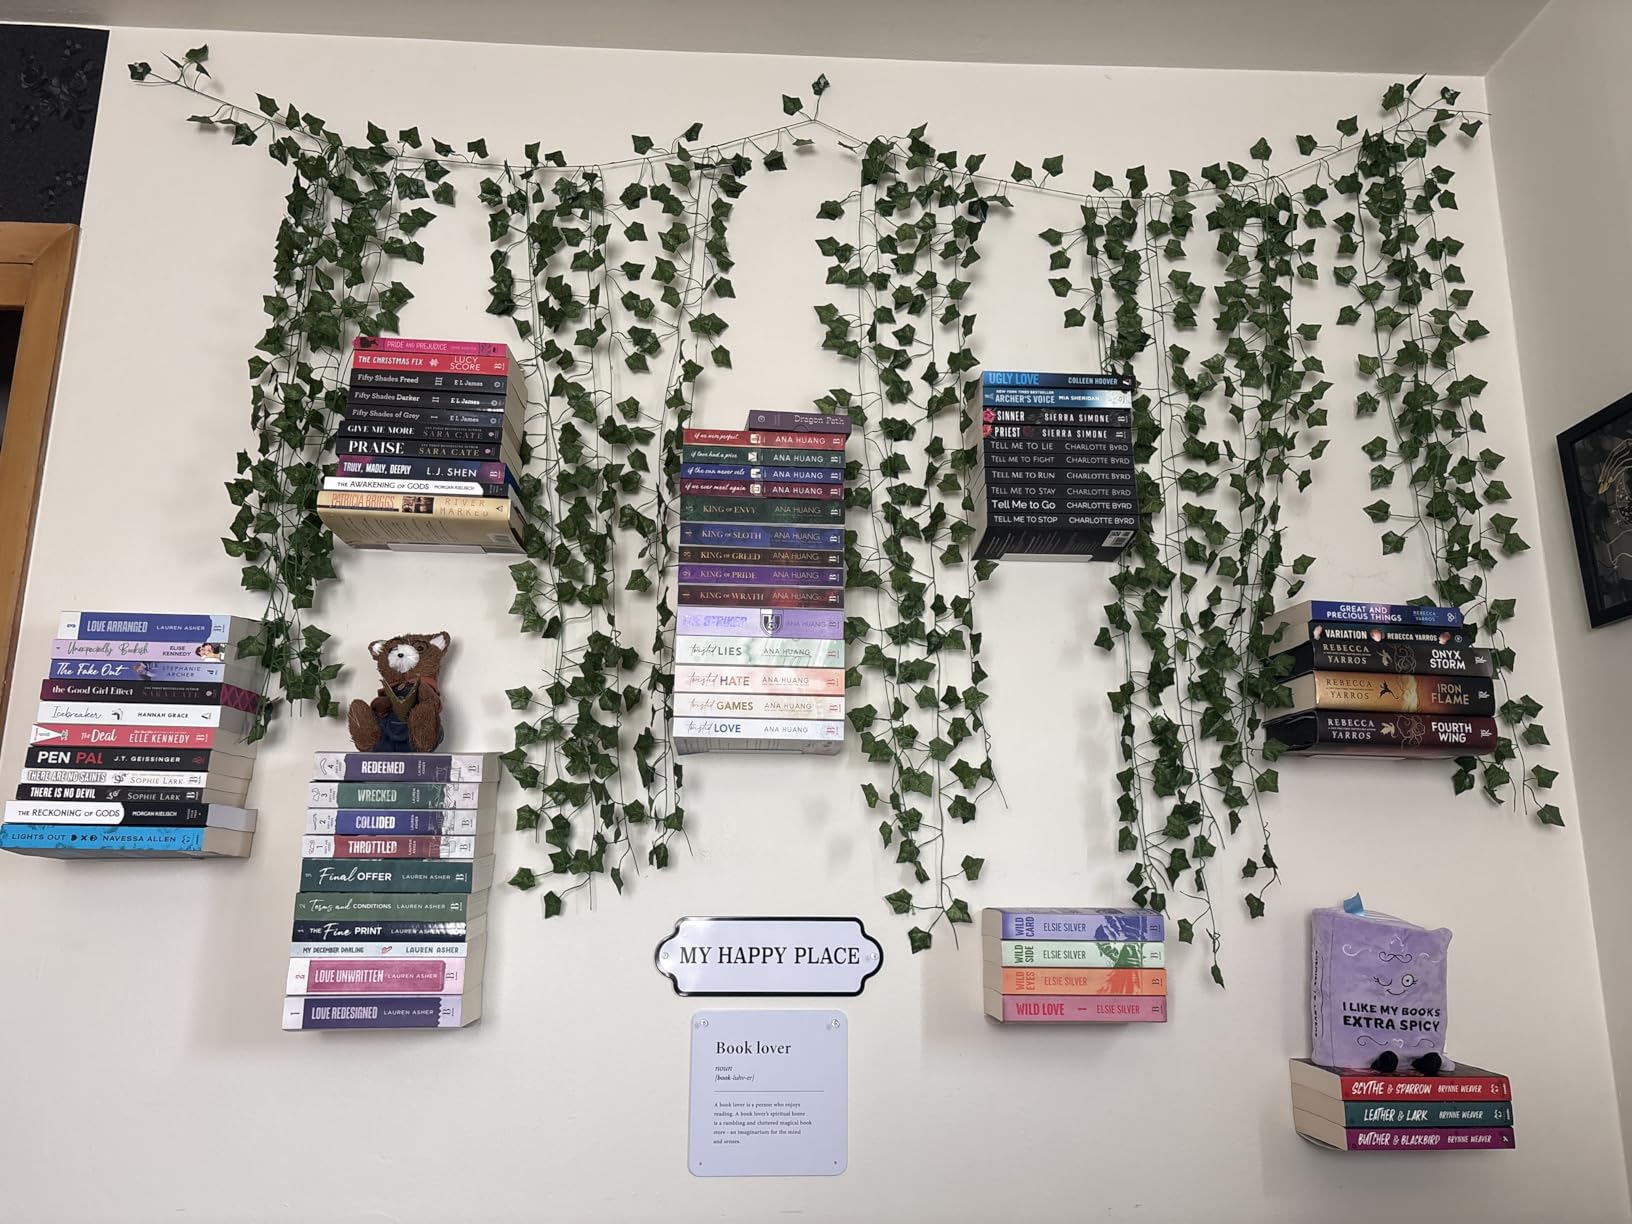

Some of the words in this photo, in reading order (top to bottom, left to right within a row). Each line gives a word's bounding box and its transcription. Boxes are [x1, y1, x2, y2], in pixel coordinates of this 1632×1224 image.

[358, 356, 370, 364] THE
[373, 356, 409, 365] CHRISTMAS
[412, 358, 423, 366] FIX
[454, 356, 477, 364] LUCY
[450, 363, 480, 371] SCORE
[358, 374, 373, 382] Fifty
[400, 376, 418, 384] Freed
[989, 373, 1013, 385] UGLY
[1016, 373, 1039, 385] LOVE
[354, 392, 370, 400] Fifty
[396, 394, 420, 402] Darker
[995, 394, 1032, 404] ARCHER'S
[1033, 395, 1055, 404] VOICE
[997, 411, 1024, 421] SINNER
[1045, 413, 1074, 422] SIERRA
[1079, 415, 1109, 423] SIMONE
[348, 425, 368, 433] GIVE
[388, 427, 415, 435] MORE
[995, 427, 1020, 438] PRIEST
[1042, 429, 1072, 438] SIERRA
[1077, 430, 1107, 438] SIMONE
[349, 441, 404, 454] PRAISE
[991, 441, 1008, 450] TELL
[1012, 442, 1023, 450] ME
[1026, 442, 1038, 450] TO
[1042, 442, 1053, 450] LIE
[343, 462, 364, 473] TRULY,
[366, 463, 387, 474] MADLY,
[390, 464, 411, 475] DEEPLY
[427, 468, 444, 476] L.J.
[447, 468, 477, 478] SHEN
[992, 500, 1010, 510] Tell
[1012, 500, 1028, 510] Me
[1030, 500, 1039, 510] to
[1041, 501, 1056, 510] Go
[1038, 516, 1058, 524] STOP
[701, 551, 722, 559] KING
[732, 552, 760, 560] GREED
[732, 592, 764, 601] WRATH
[1340, 604, 1366, 614] GREAT
[1327, 611, 1368, 621] PRECIOUS
[1371, 613, 1402, 622] THINGS
[87, 620, 105, 632] LOVE
[107, 621, 148, 633] ARRANGED
[1325, 629, 1367, 640] VARIATION
[718, 647, 742, 656] LIES
[1432, 650, 1462, 661] ONYX
[57, 663, 74, 676] The
[76, 664, 99, 676] Fake
[102, 664, 130, 676] Out
[1430, 659, 1465, 670] STORM
[720, 676, 750, 686] HATE
[1437, 683, 1462, 694] IRON
[1432, 693, 1469, 705] FLAME
[51, 706, 102, 720] Icebreaker
[714, 724, 741, 733] LOVE
[1432, 721, 1472, 733] FOURTH
[129, 733, 149, 743] ELLE
[151, 733, 190, 744] KENNEDY
[1439, 732, 1466, 743] WING
[37, 752, 70, 763] PEN
[76, 754, 103, 764] PAL
[361, 760, 404, 774] REDEEMED
[30, 787, 53, 797] THERE
[55, 788, 62, 797] IS
[64, 788, 75, 798] NO
[76, 788, 96, 799] DEVIL
[358, 789, 397, 802] WRECKED
[356, 816, 395, 829] COLLIDED
[319, 867, 357, 885] Final
[357, 873, 392, 881] OFFER
[1015, 917, 1024, 936] WILD
[1026, 917, 1034, 936] CARD
[1044, 923, 1061, 932] ELSIE
[1064, 923, 1086, 932] SILVER
[680, 946, 712, 964] MY
[718, 946, 787, 964] HAPPY
[794, 947, 860, 965] PLACE
[1015, 944, 1023, 963] WILD
[1025, 945, 1034, 962] SIDE
[1043, 950, 1061, 959] ELSIE
[1064, 951, 1086, 959] SILVER
[315, 970, 334, 983] LOVE
[337, 970, 384, 983] UNWRITTEN
[1016, 972, 1024, 990] WILD
[1045, 977, 1062, 985] ELSIE
[1065, 977, 1087, 986] SILVER
[312, 1007, 330, 1020] LOVE
[332, 1007, 378, 1019] REDESIGNED
[1016, 1003, 1039, 1016] WILD
[1042, 1003, 1065, 1016] LOVE
[1097, 1005, 1115, 1014] ELSIE
[1117, 1005, 1140, 1014] SILVER
[1343, 1002, 1346, 1011] I
[1350, 1002, 1376, 1013] LIKE
[1380, 1006, 1398, 1015] MY
[1402, 1007, 1440, 1017] BOOKS
[1343, 1016, 1395, 1030] EXTRA
[1400, 1020, 1440, 1032] SPICY
[716, 1040, 752, 1054] Book
[756, 1041, 792, 1054] lover
[1352, 1081, 1384, 1095] SCYTHE
[1387, 1085, 1393, 1093] &
[1396, 1083, 1432, 1094] SPARROW
[1438, 1085, 1459, 1093] BRYNNE
[1461, 1085, 1482, 1093] WEAVER
[1364, 1107, 1396, 1122] LEATHER
[1398, 1112, 1404, 1121] &
[1406, 1110, 1428, 1121] LARK
[1439, 1111, 1460, 1119] BRYNNE
[1462, 1111, 1483, 1119] WEAVER
[1358, 1132, 1390, 1146] BUTCHER
[1393, 1137, 1399, 1145] &
[1401, 1135, 1440, 1145] BLACKBIRD
